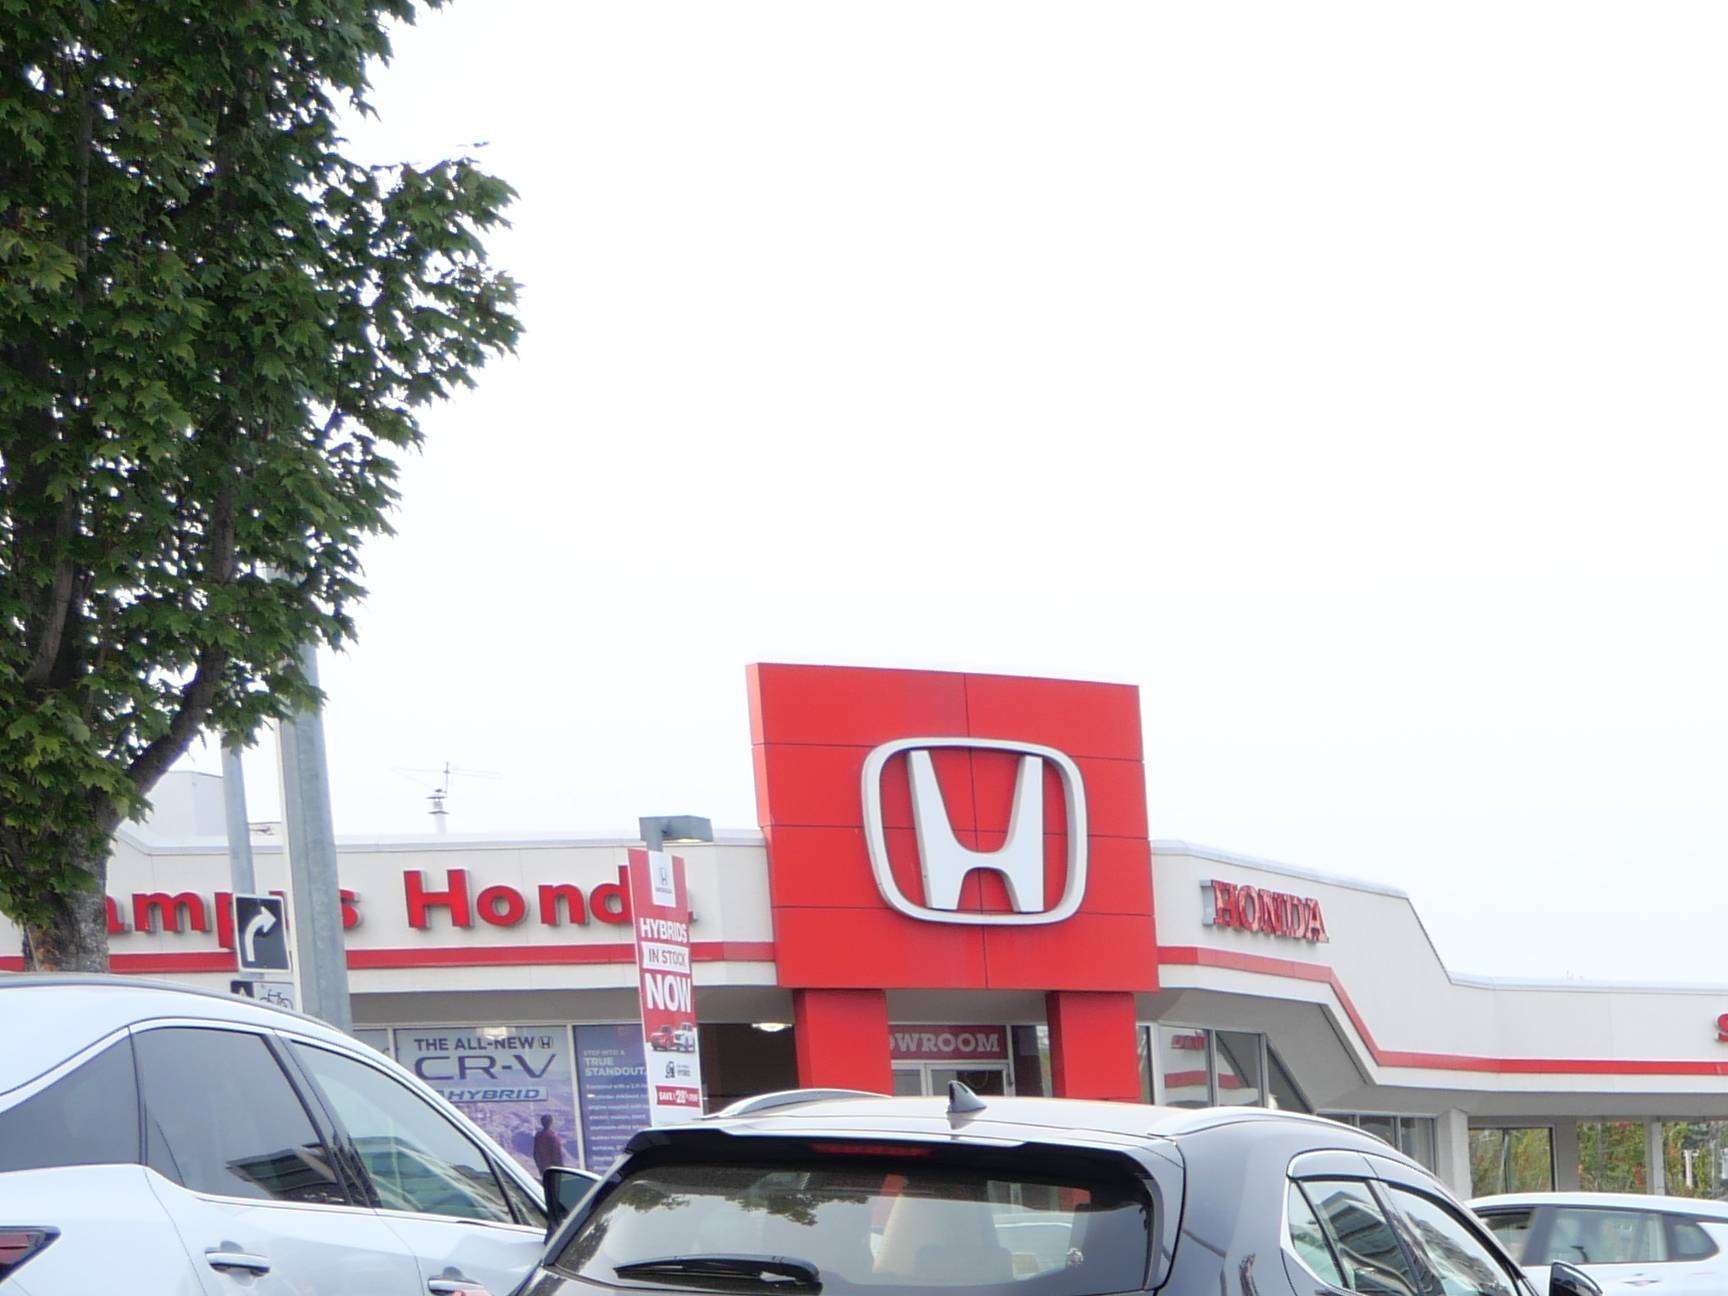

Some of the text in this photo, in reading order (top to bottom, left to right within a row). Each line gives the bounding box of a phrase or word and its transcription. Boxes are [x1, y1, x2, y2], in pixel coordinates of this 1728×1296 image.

[403, 864, 692, 928] Hond
[1200, 879, 1330, 943] HONDA
[640, 917, 688, 943] HYBRIDS
[649, 948, 687, 967] IN STOCK
[644, 972, 691, 1013] NOW
[414, 1036, 534, 1051] THE ALL-NEW
[889, 1033, 1000, 1052] WROOM
[415, 1053, 557, 1081] CR-V
[448, 1088, 540, 1101] HYBRID
